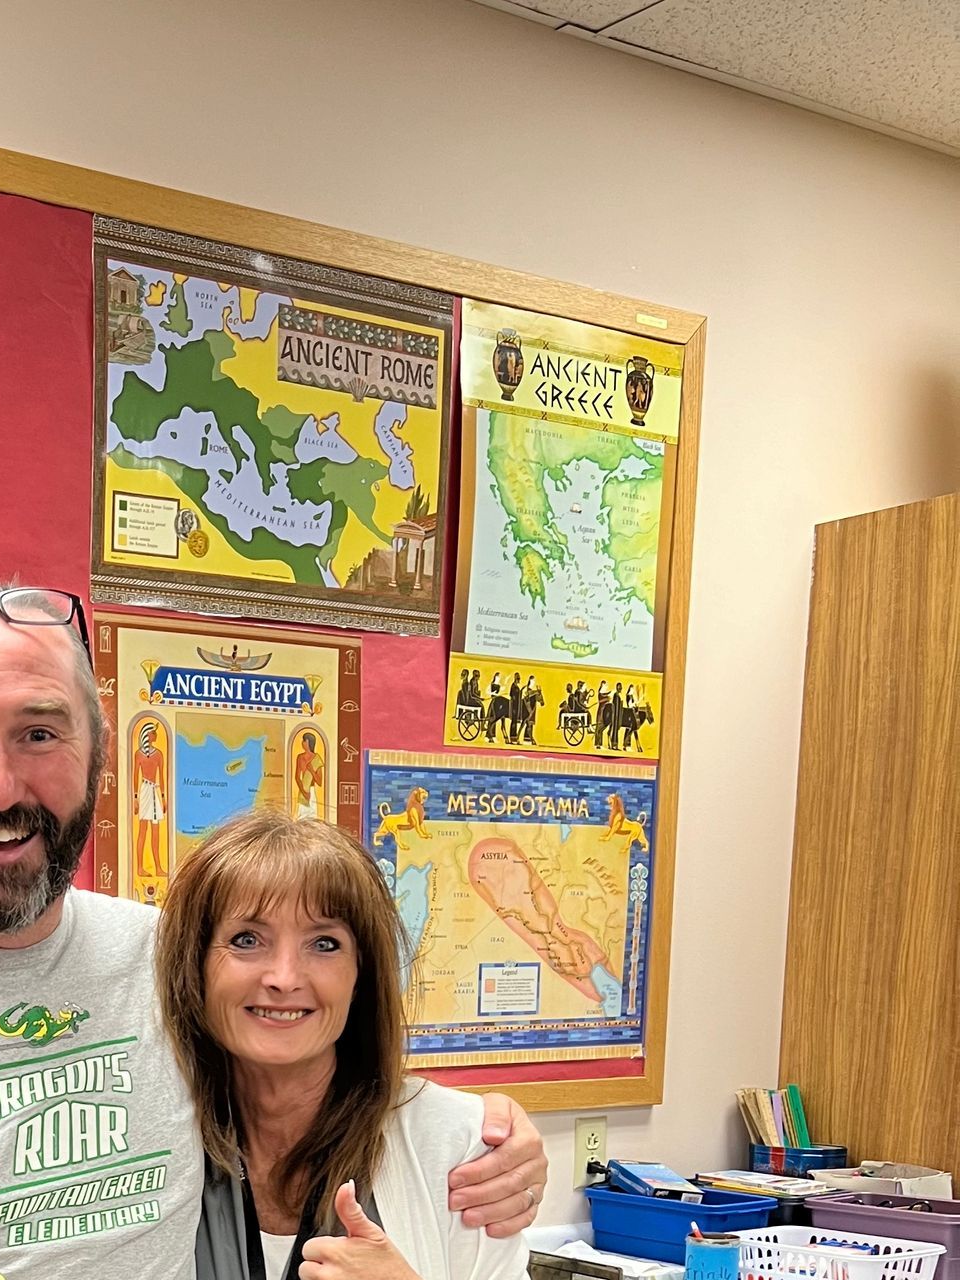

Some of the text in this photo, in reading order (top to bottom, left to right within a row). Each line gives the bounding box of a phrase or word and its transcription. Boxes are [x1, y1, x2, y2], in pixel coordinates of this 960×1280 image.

[195, 291, 218, 302] NORTH
[200, 301, 213, 310] SEA
[281, 336, 434, 389] ANCIENT ROME
[530, 354, 622, 391] ANCIENT
[534, 382, 613, 419] GREECE
[304, 437, 339, 449] BLACK SEA
[525, 427, 563, 440] MACEDONIA
[210, 444, 229, 455] ROME
[380, 424, 408, 475] CASPIAN SEA
[214, 479, 321, 530] MEDITERRANEAN SEA
[477, 607, 528, 620] Mediterranean Sea
[163, 672, 304, 704] ANCIENT EGYPT
[183, 778, 228, 787] Mediterranean
[447, 793, 589, 818] MESOPOTAMIA
[481, 852, 508, 860] ASSYRIA
[13, 1100, 128, 1176] ROAR
[101, 1165, 167, 1200] GREEN
[7, 1200, 160, 1247] ELEMENTARY
